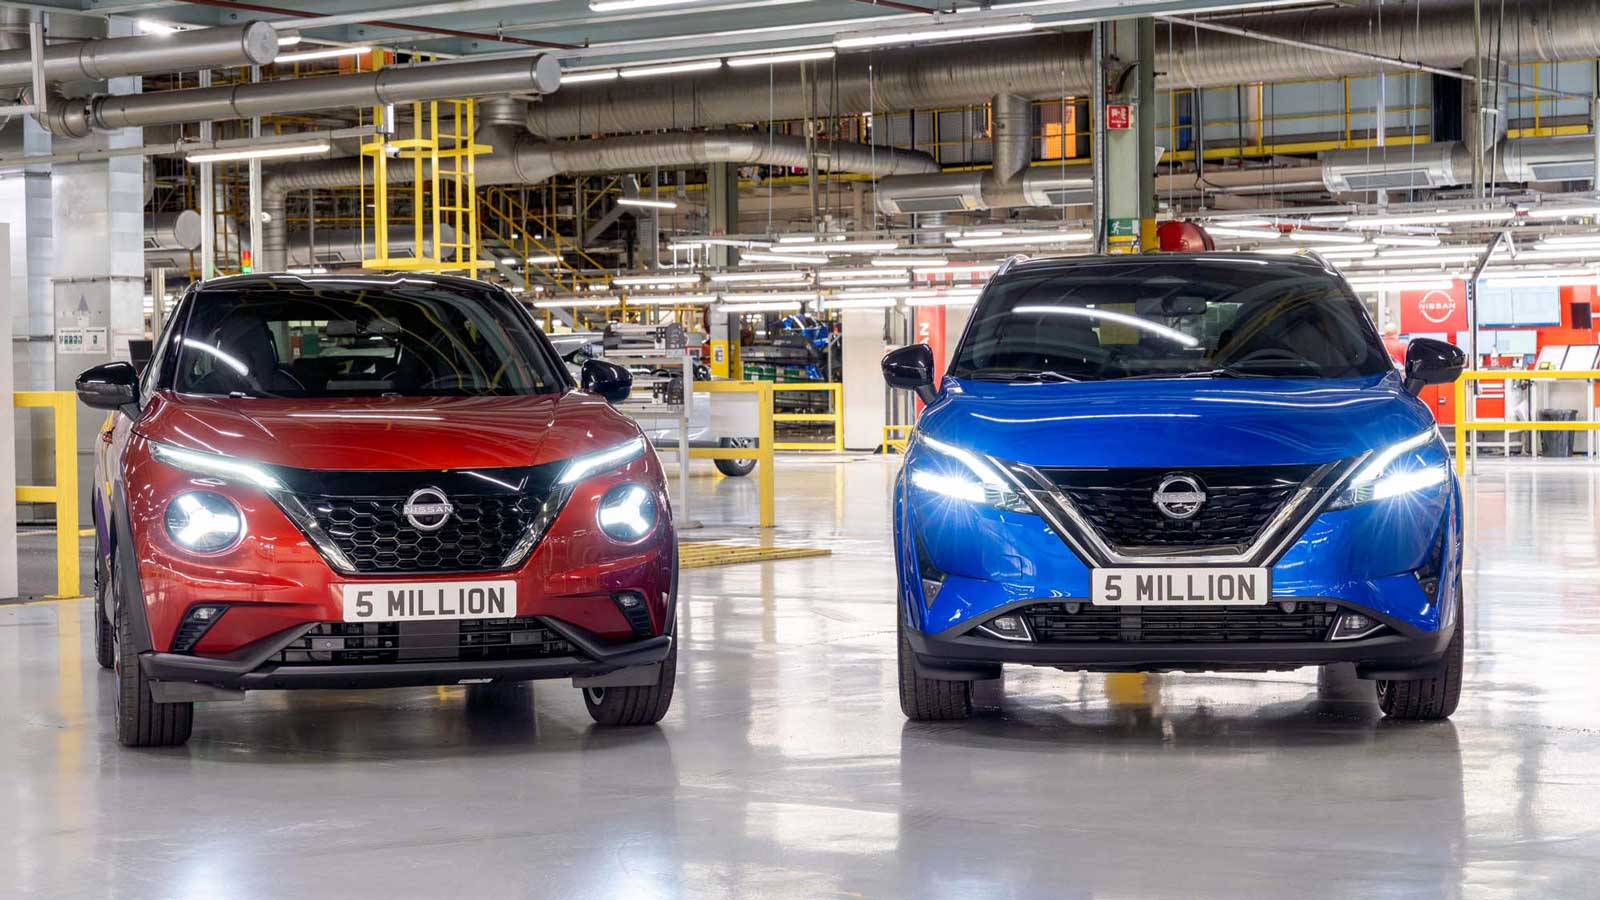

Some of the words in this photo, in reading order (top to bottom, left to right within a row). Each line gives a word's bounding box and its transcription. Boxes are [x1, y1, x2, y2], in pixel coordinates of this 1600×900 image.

[404, 506, 453, 515] NISSAN
[1105, 574, 1122, 601] 5
[1136, 574, 1256, 601] MILLION
[355, 591, 374, 618] 5
[387, 587, 505, 617] MILLION
